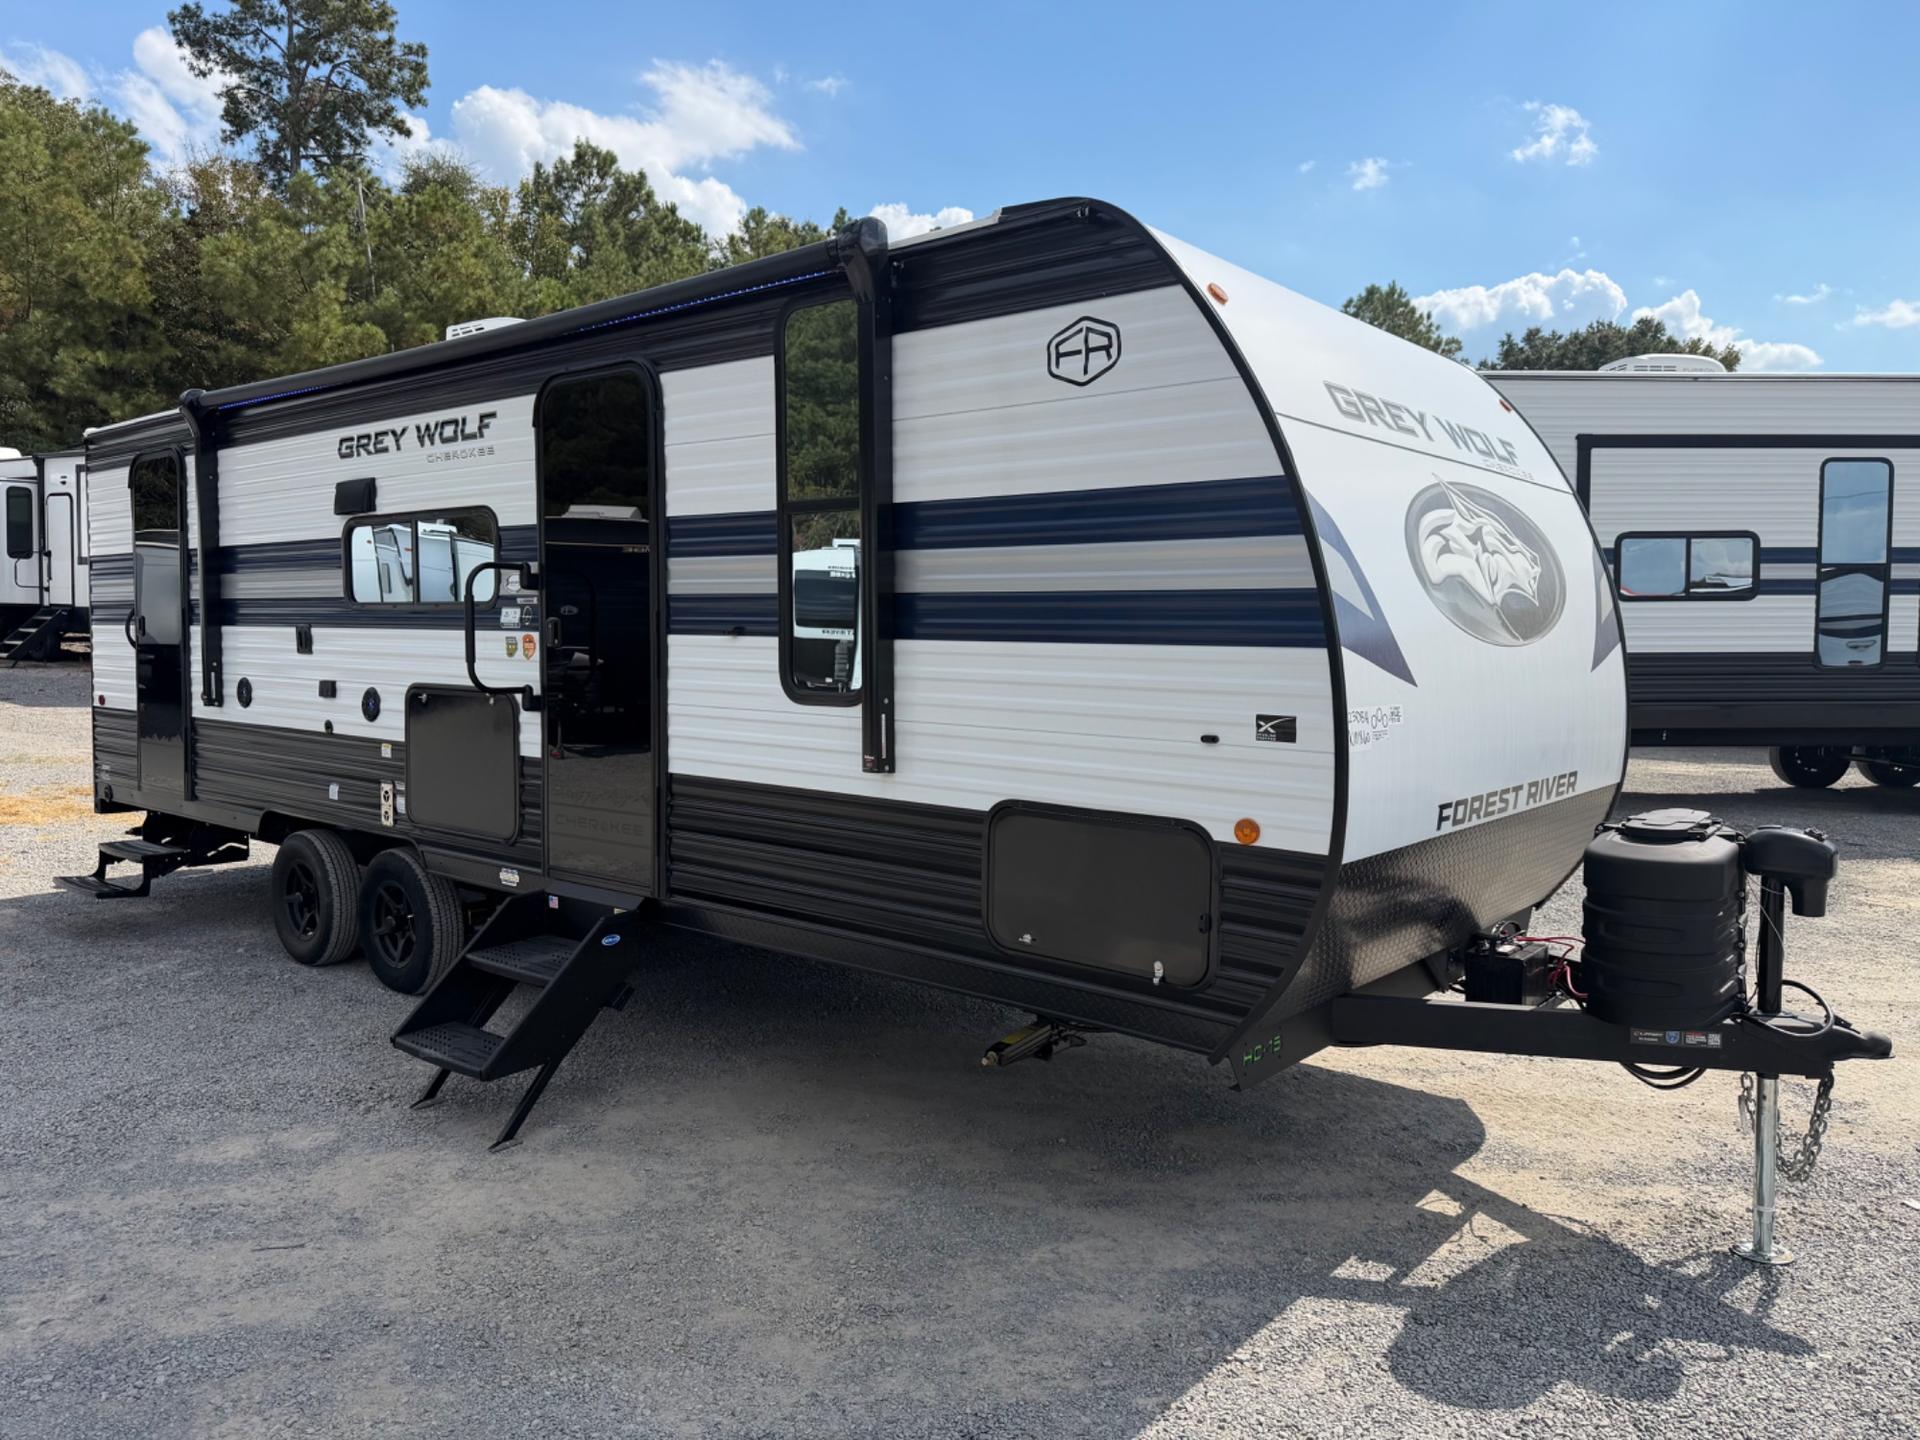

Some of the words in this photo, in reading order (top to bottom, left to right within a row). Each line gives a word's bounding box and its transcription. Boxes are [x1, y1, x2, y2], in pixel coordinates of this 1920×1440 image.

[337, 426, 409, 459] GREY
[415, 411, 497, 448] WOLF
[1323, 380, 1435, 441] GREY
[1432, 415, 1519, 467] WOLF
[1436, 784, 1524, 831] FOREST
[1526, 770, 1578, 806] RIVER
